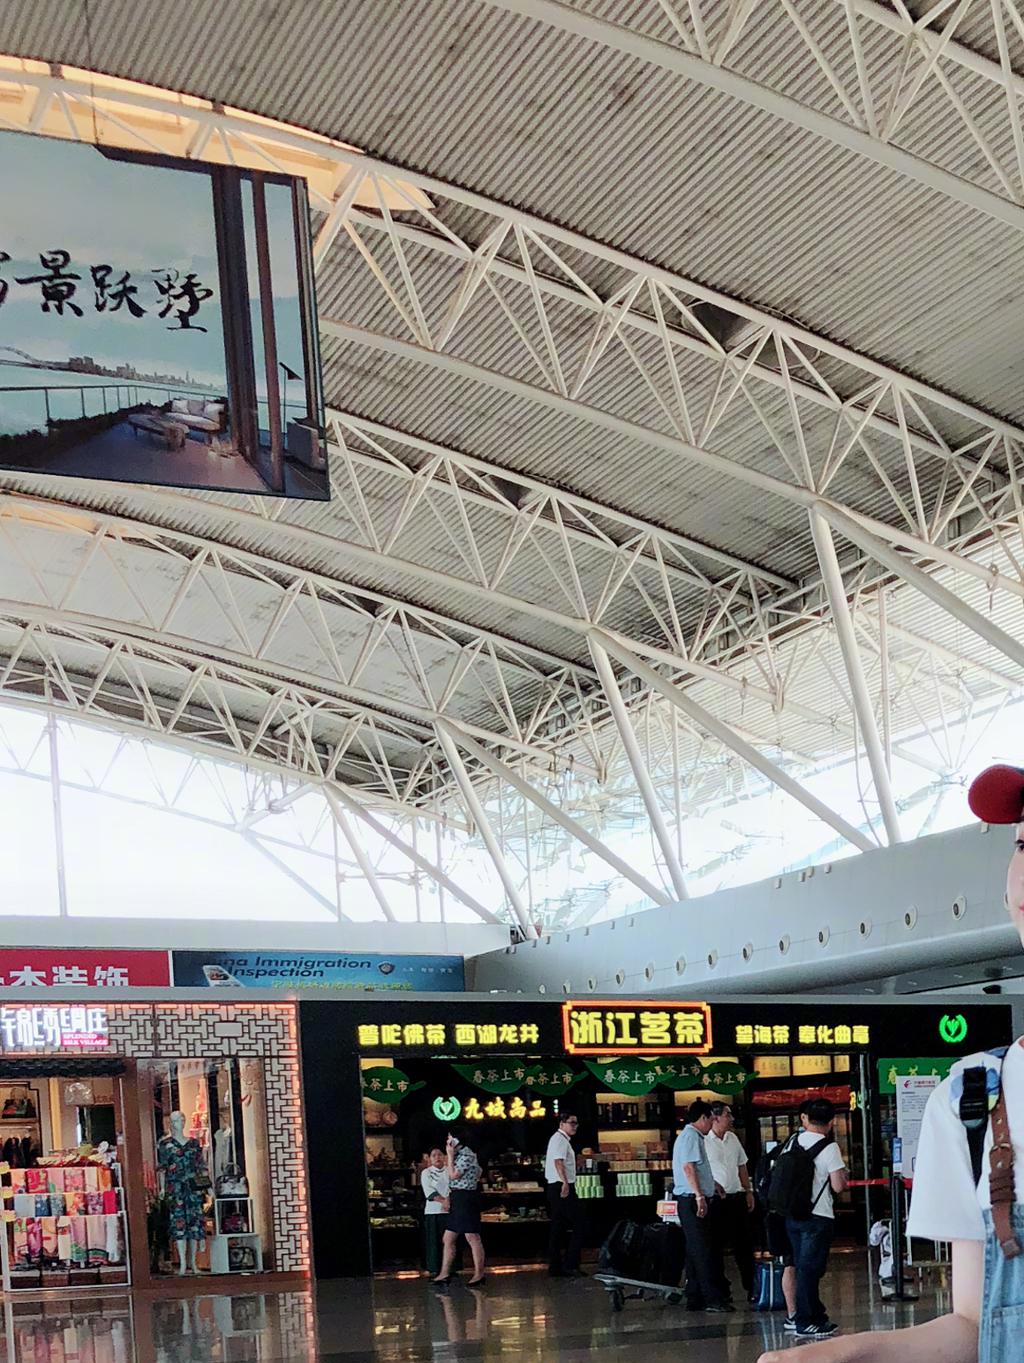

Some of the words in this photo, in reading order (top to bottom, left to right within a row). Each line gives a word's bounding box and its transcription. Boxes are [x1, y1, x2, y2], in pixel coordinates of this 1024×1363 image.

[256, 956, 372, 969] Immigration
[229, 966, 324, 979] Inspection
[358, 1024, 446, 1046] 普陀佛茶
[455, 1024, 540, 1045] 西湖龙井
[570, 1011, 704, 1045] 浙江茗茶
[735, 1025, 790, 1045] 望海茶
[603, 1069, 657, 1084] 春茶上市
[701, 1071, 746, 1086] 春茶上市
